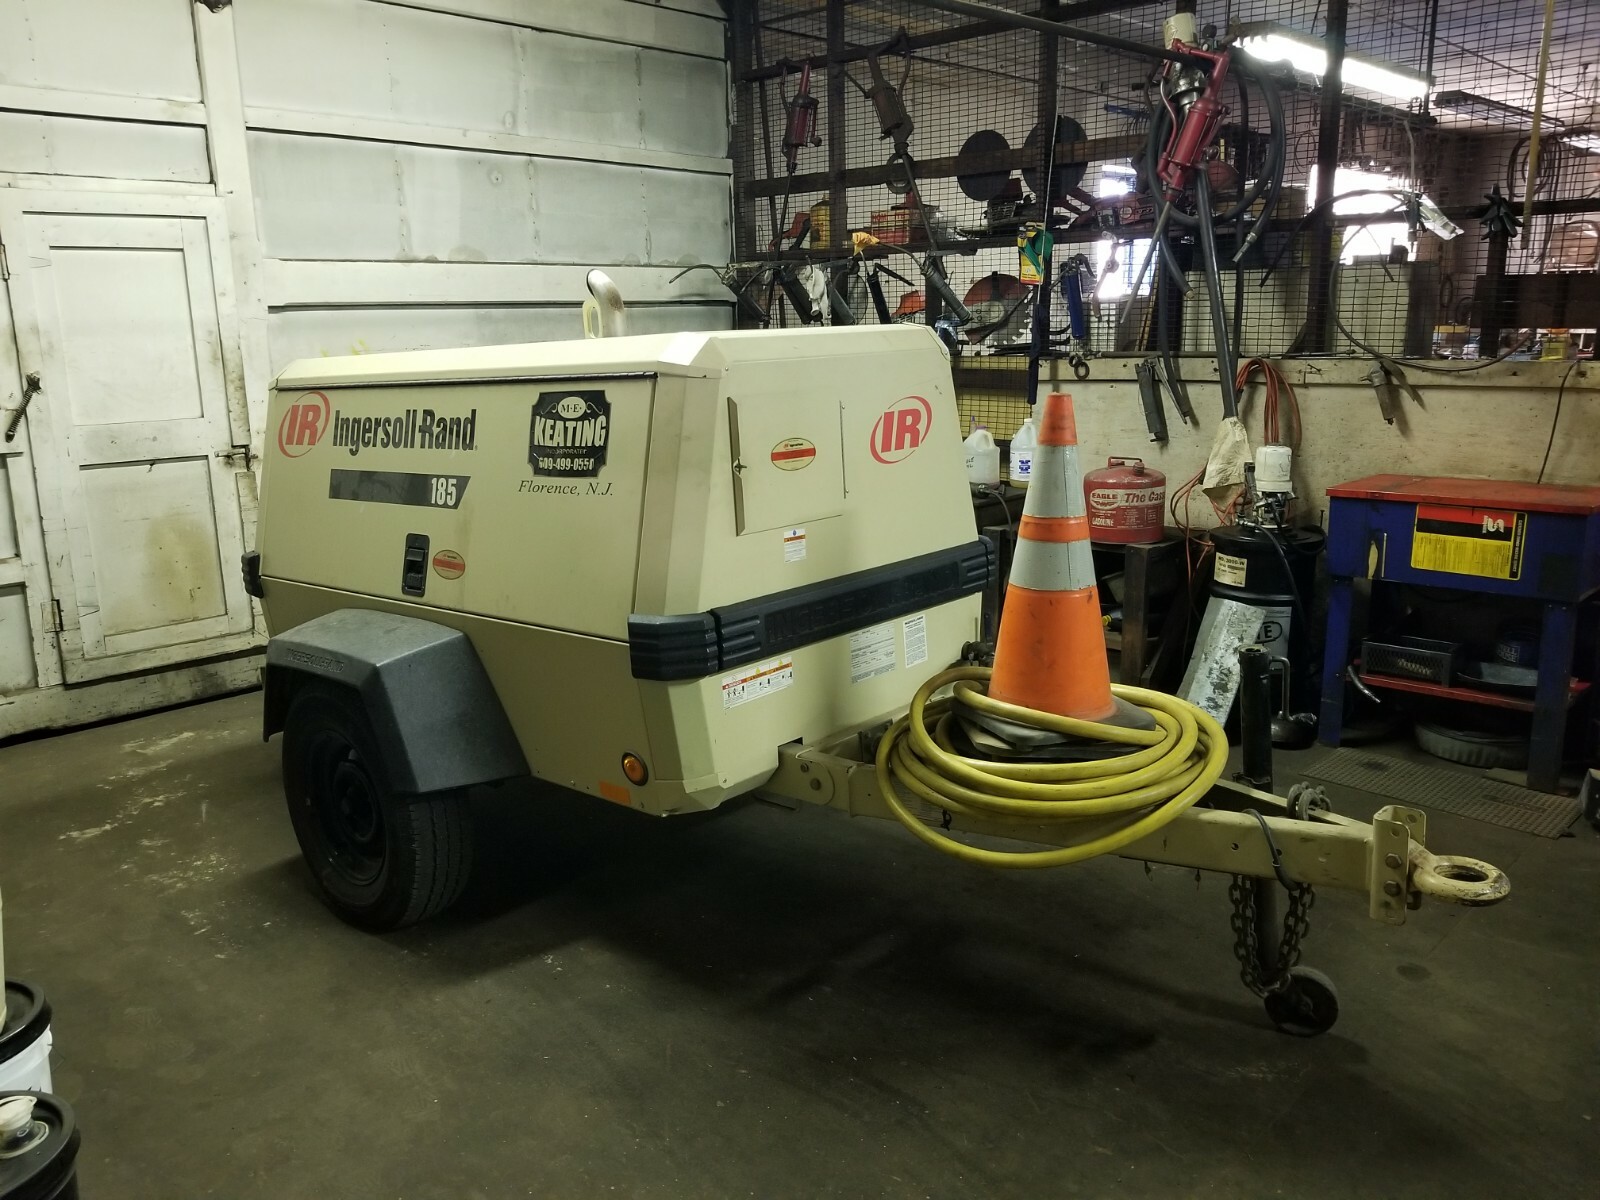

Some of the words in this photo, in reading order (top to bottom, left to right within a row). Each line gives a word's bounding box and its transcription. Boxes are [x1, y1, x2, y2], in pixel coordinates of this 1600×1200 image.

[285, 404, 321, 446] IR
[534, 415, 607, 447] KEATING
[880, 408, 922, 453] IR
[431, 477, 457, 506] 185
[518, 480, 580, 496] Florence,
[585, 482, 613, 496] N.J.
[1091, 492, 1118, 500] EAGLE
[1124, 492, 1146, 503] The
